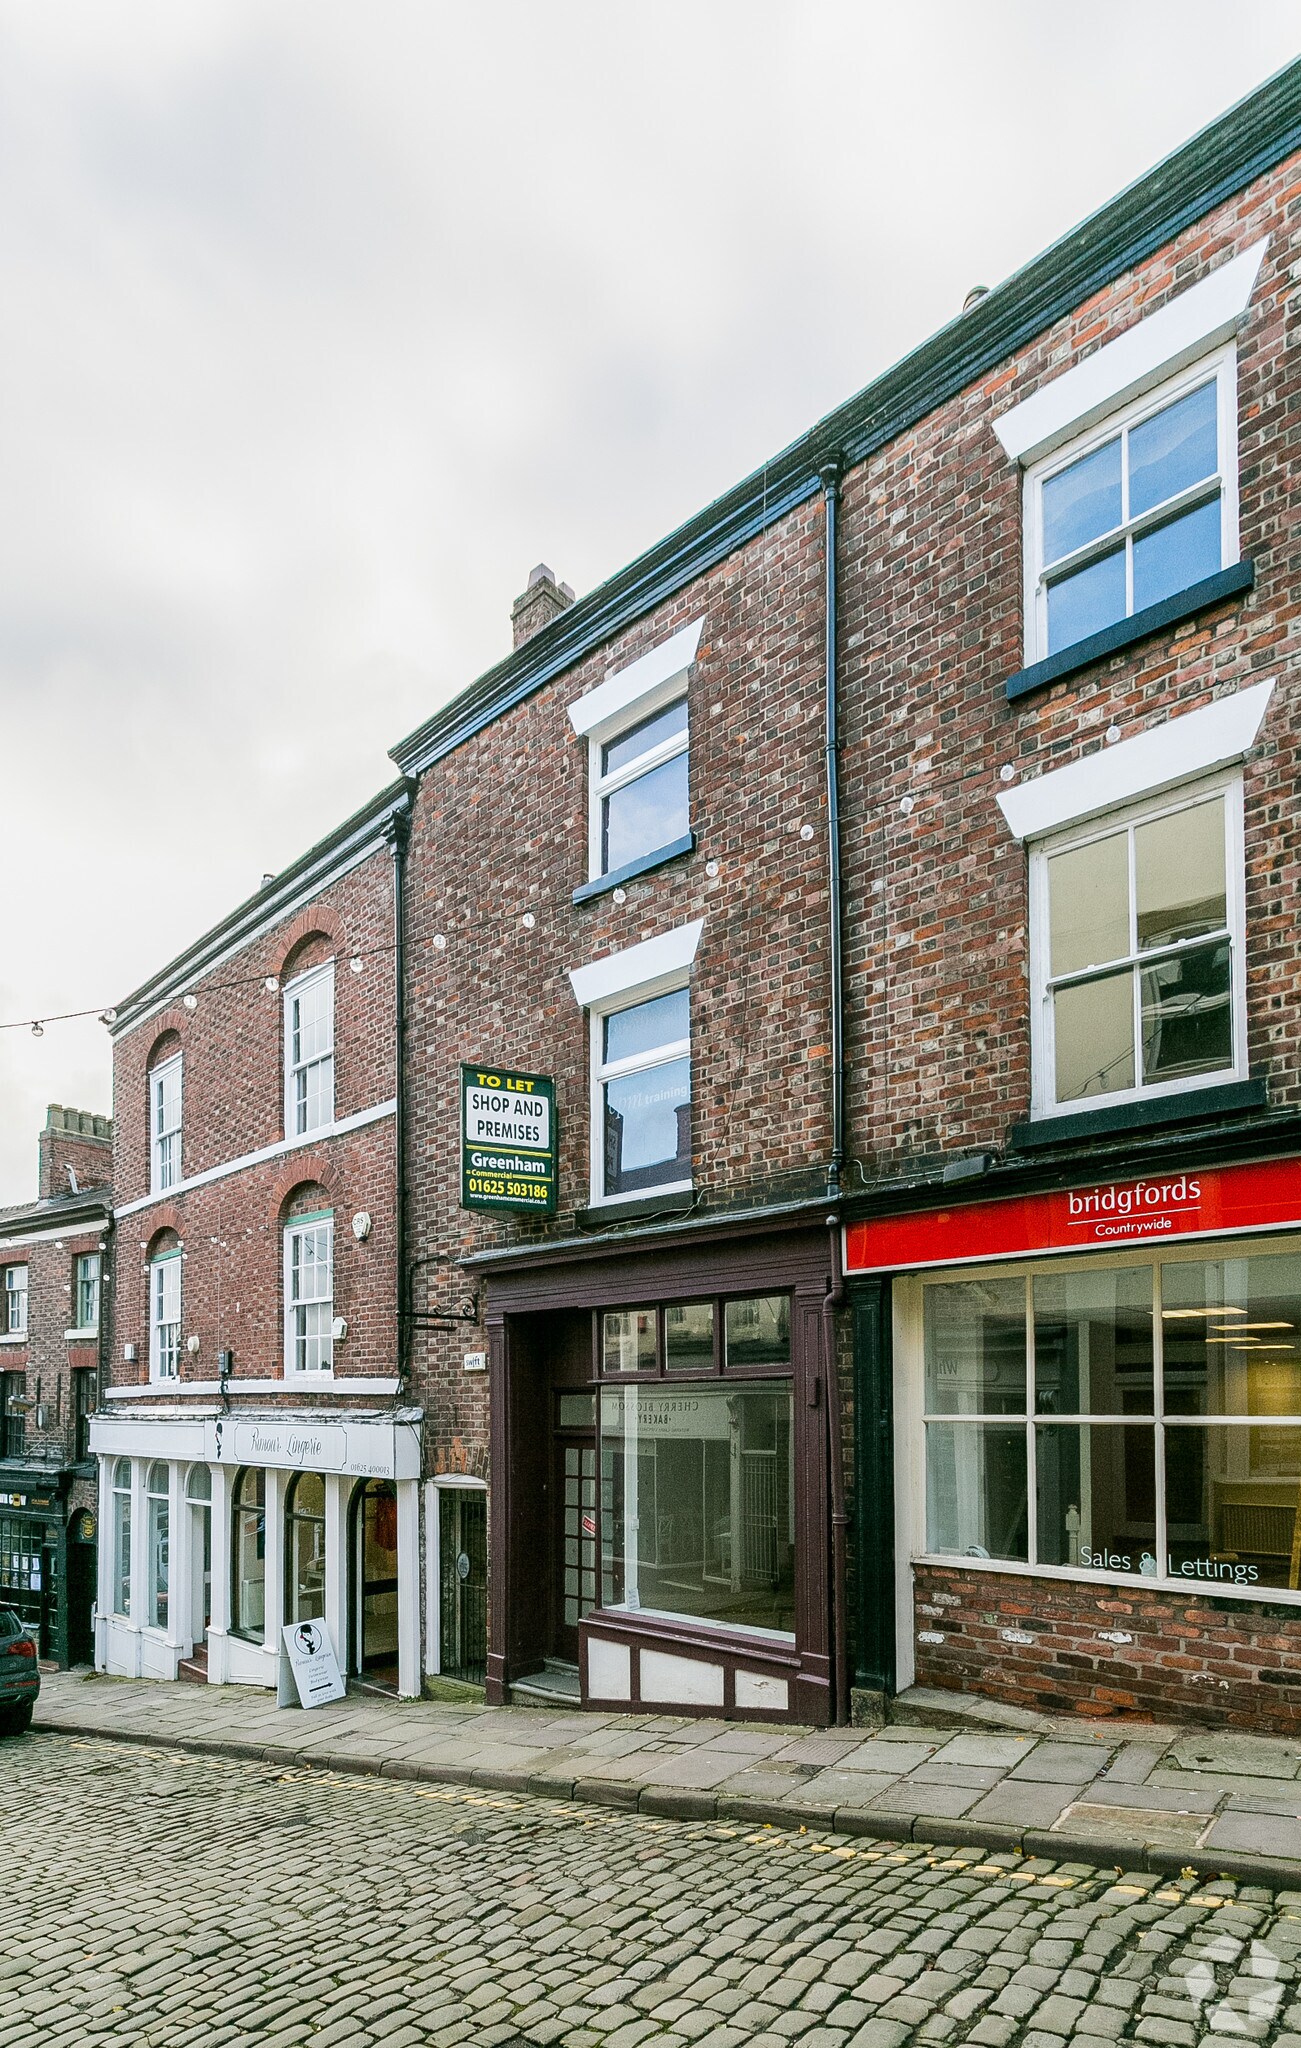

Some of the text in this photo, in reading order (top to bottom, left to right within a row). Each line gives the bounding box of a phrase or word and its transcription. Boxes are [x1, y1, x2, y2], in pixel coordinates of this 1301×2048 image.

[477, 1073, 534, 1093] TO LET
[645, 1085, 688, 1104] training
[472, 1093, 543, 1118] SHOP AND
[477, 1119, 540, 1142] PREMISES
[471, 1152, 545, 1173] Greenham
[471, 1168, 513, 1179] Commercial
[469, 1178, 548, 1198] 01625 503186
[1068, 1176, 1201, 1214] bridgfords
[1095, 1217, 1172, 1236] Countrywide
[286, 1433, 322, 1464] Lingerie
[350, 1463, 390, 1475] 01625 400013
[1080, 1546, 1259, 1586] Sales & Lettings
